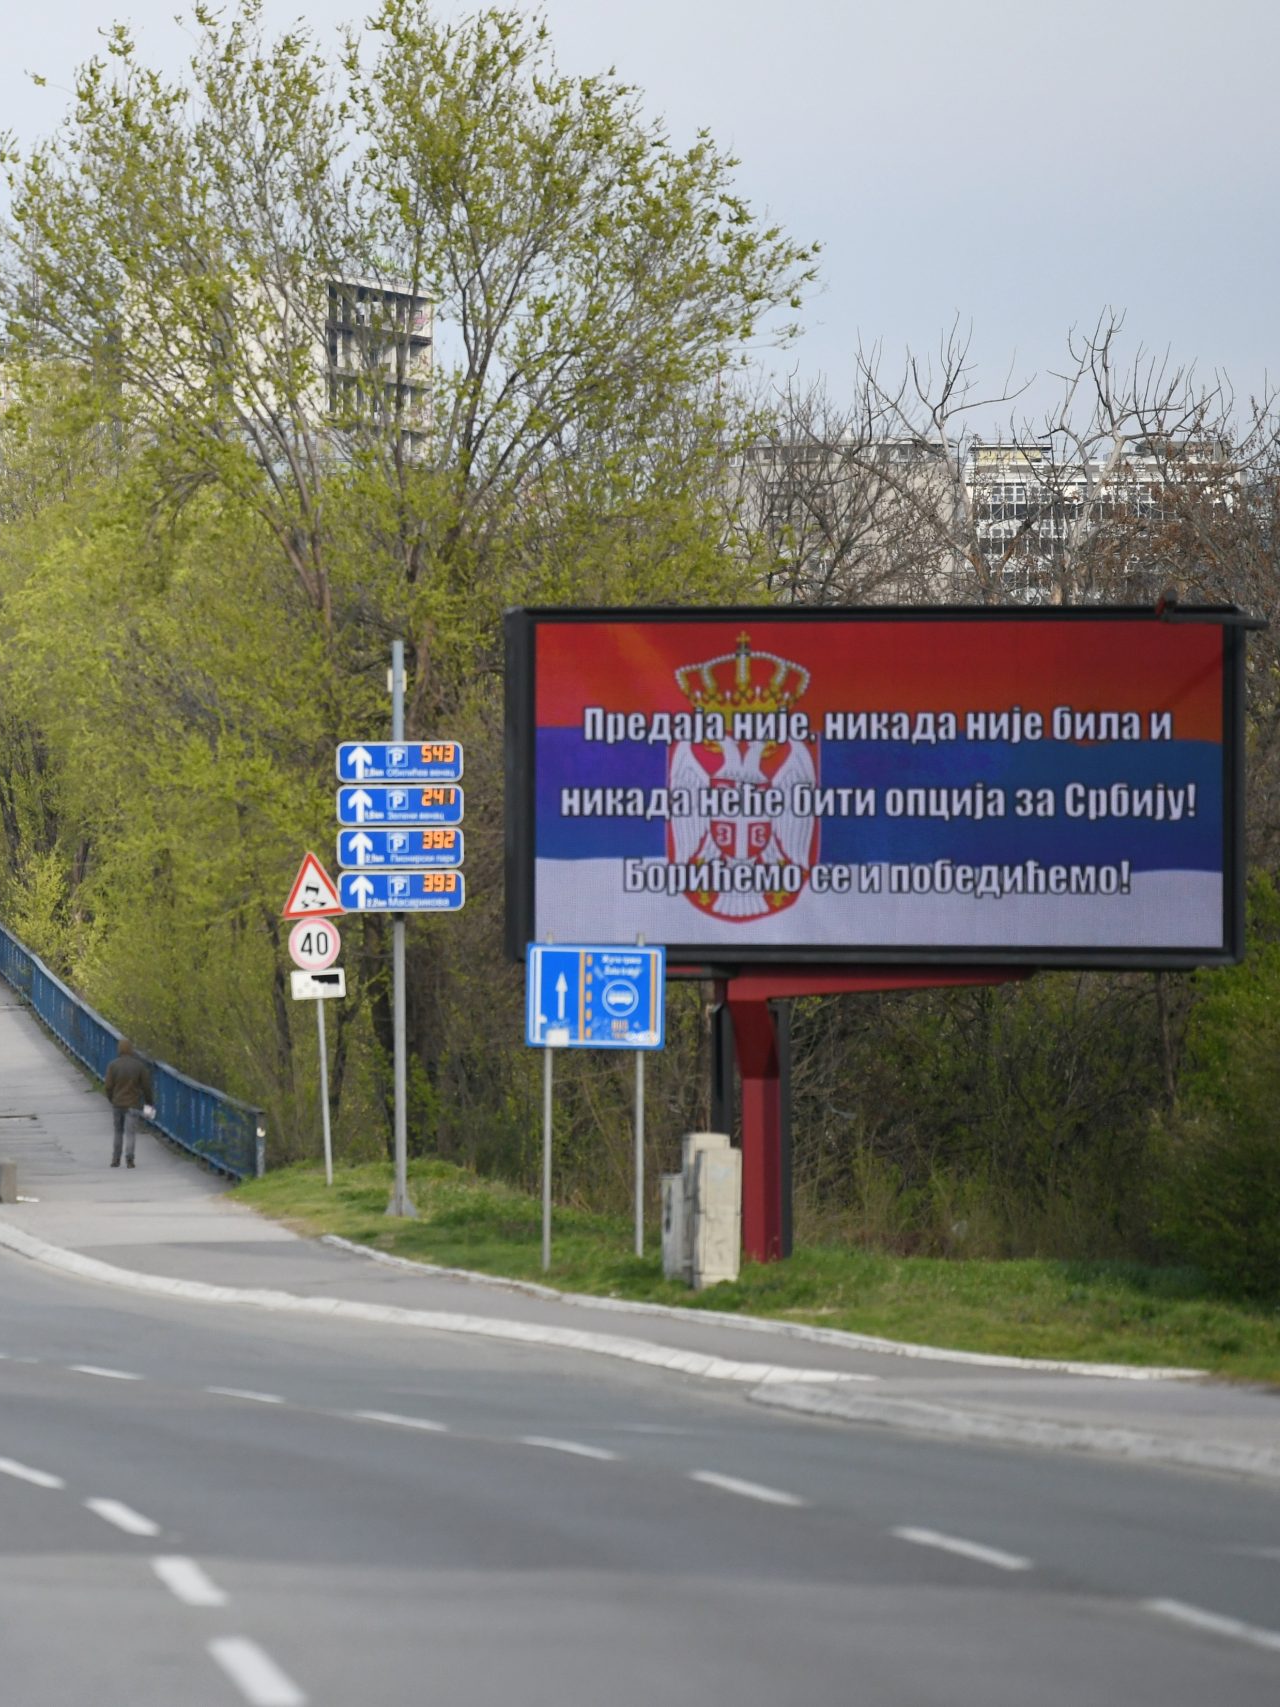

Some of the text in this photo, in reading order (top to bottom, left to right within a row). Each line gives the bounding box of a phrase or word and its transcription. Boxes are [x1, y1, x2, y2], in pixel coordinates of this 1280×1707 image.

[584, 707, 725, 744] Предаја
[825, 712, 957, 744] никада
[966, 706, 1043, 744] није
[1052, 706, 1141, 741] била
[1150, 712, 1172, 741] и
[421, 743, 456, 763] 543
[421, 786, 457, 807] 241
[561, 782, 1197, 821] никада неће бити опција за Србију!
[422, 830, 457, 850] 392
[422, 873, 457, 893] 393
[623, 858, 1132, 898] Борићемо се и победићемо!
[300, 931, 328, 956] 40
